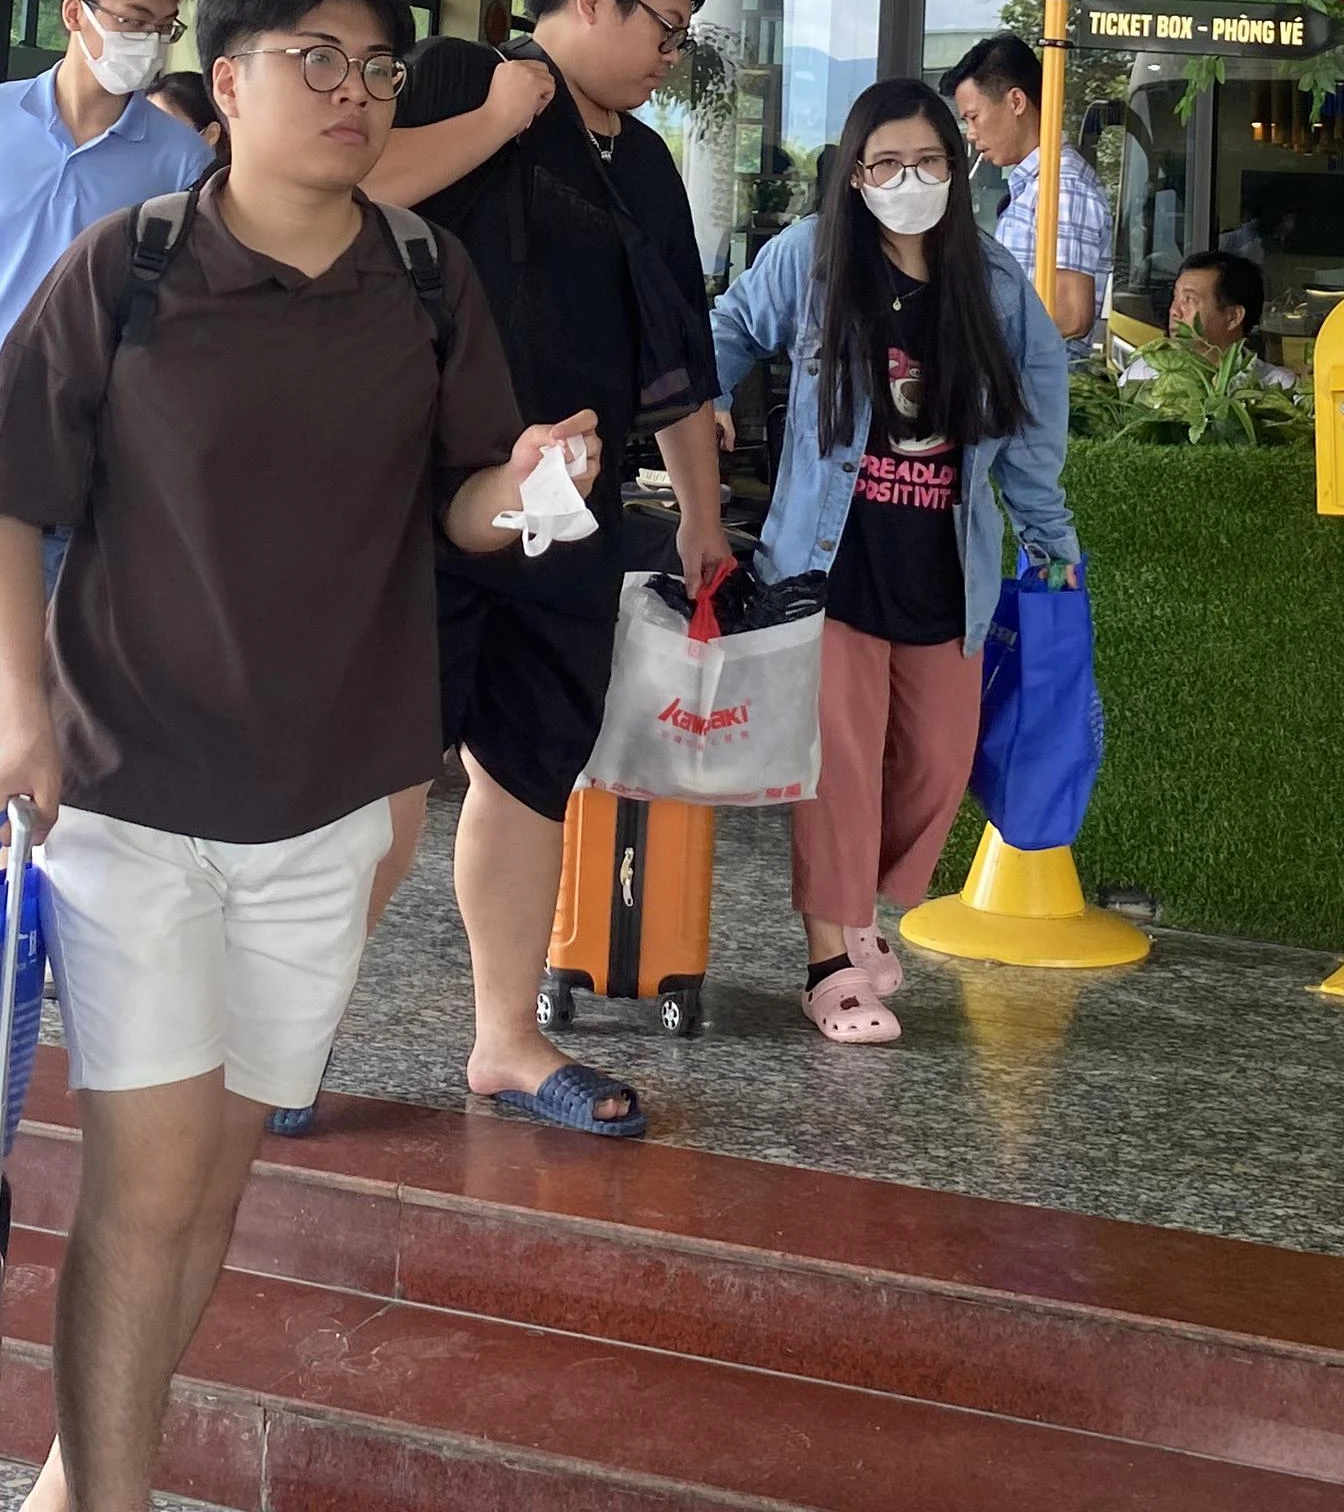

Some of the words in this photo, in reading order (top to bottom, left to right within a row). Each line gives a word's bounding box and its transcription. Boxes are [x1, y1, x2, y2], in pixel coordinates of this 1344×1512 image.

[1089, 11, 1153, 37] TICKET
[1156, 15, 1193, 39] BOX
[1212, 14, 1275, 44] PHÒNG
